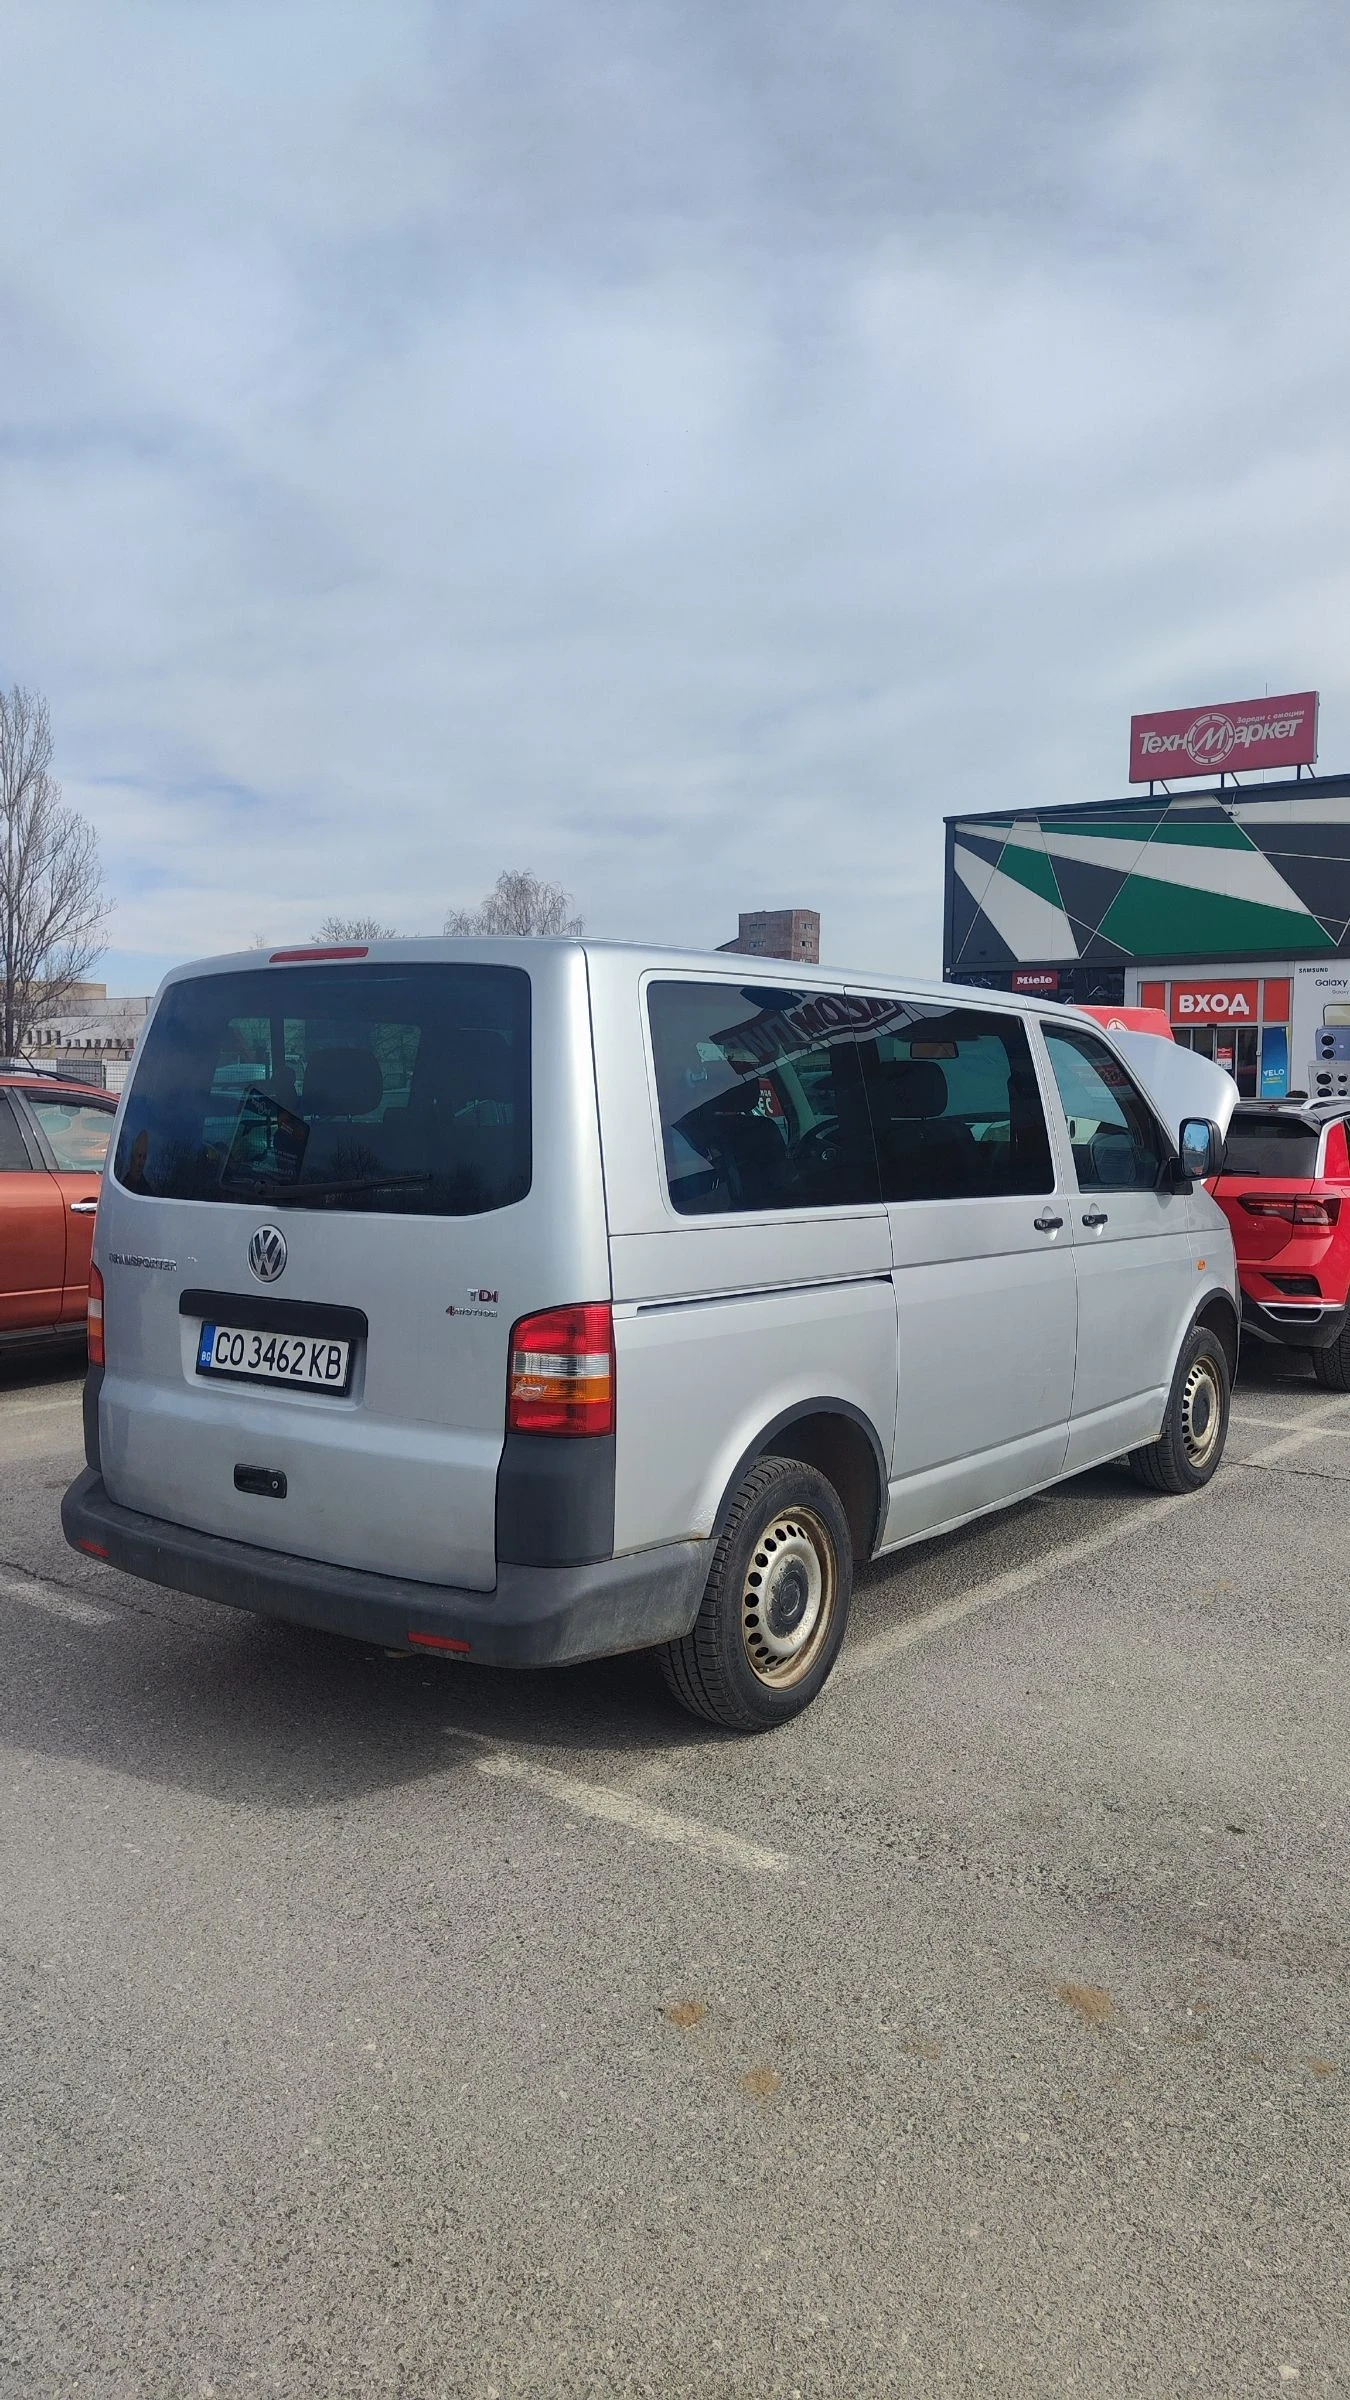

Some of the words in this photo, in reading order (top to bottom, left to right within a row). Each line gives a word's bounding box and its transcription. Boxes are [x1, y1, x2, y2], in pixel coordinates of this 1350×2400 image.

[1016, 975, 1053, 985] Miele
[1314, 978, 1349, 988] Galaxy
[1179, 993, 1250, 1016] ВХОД
[466, 1288, 499, 1303] TDI
